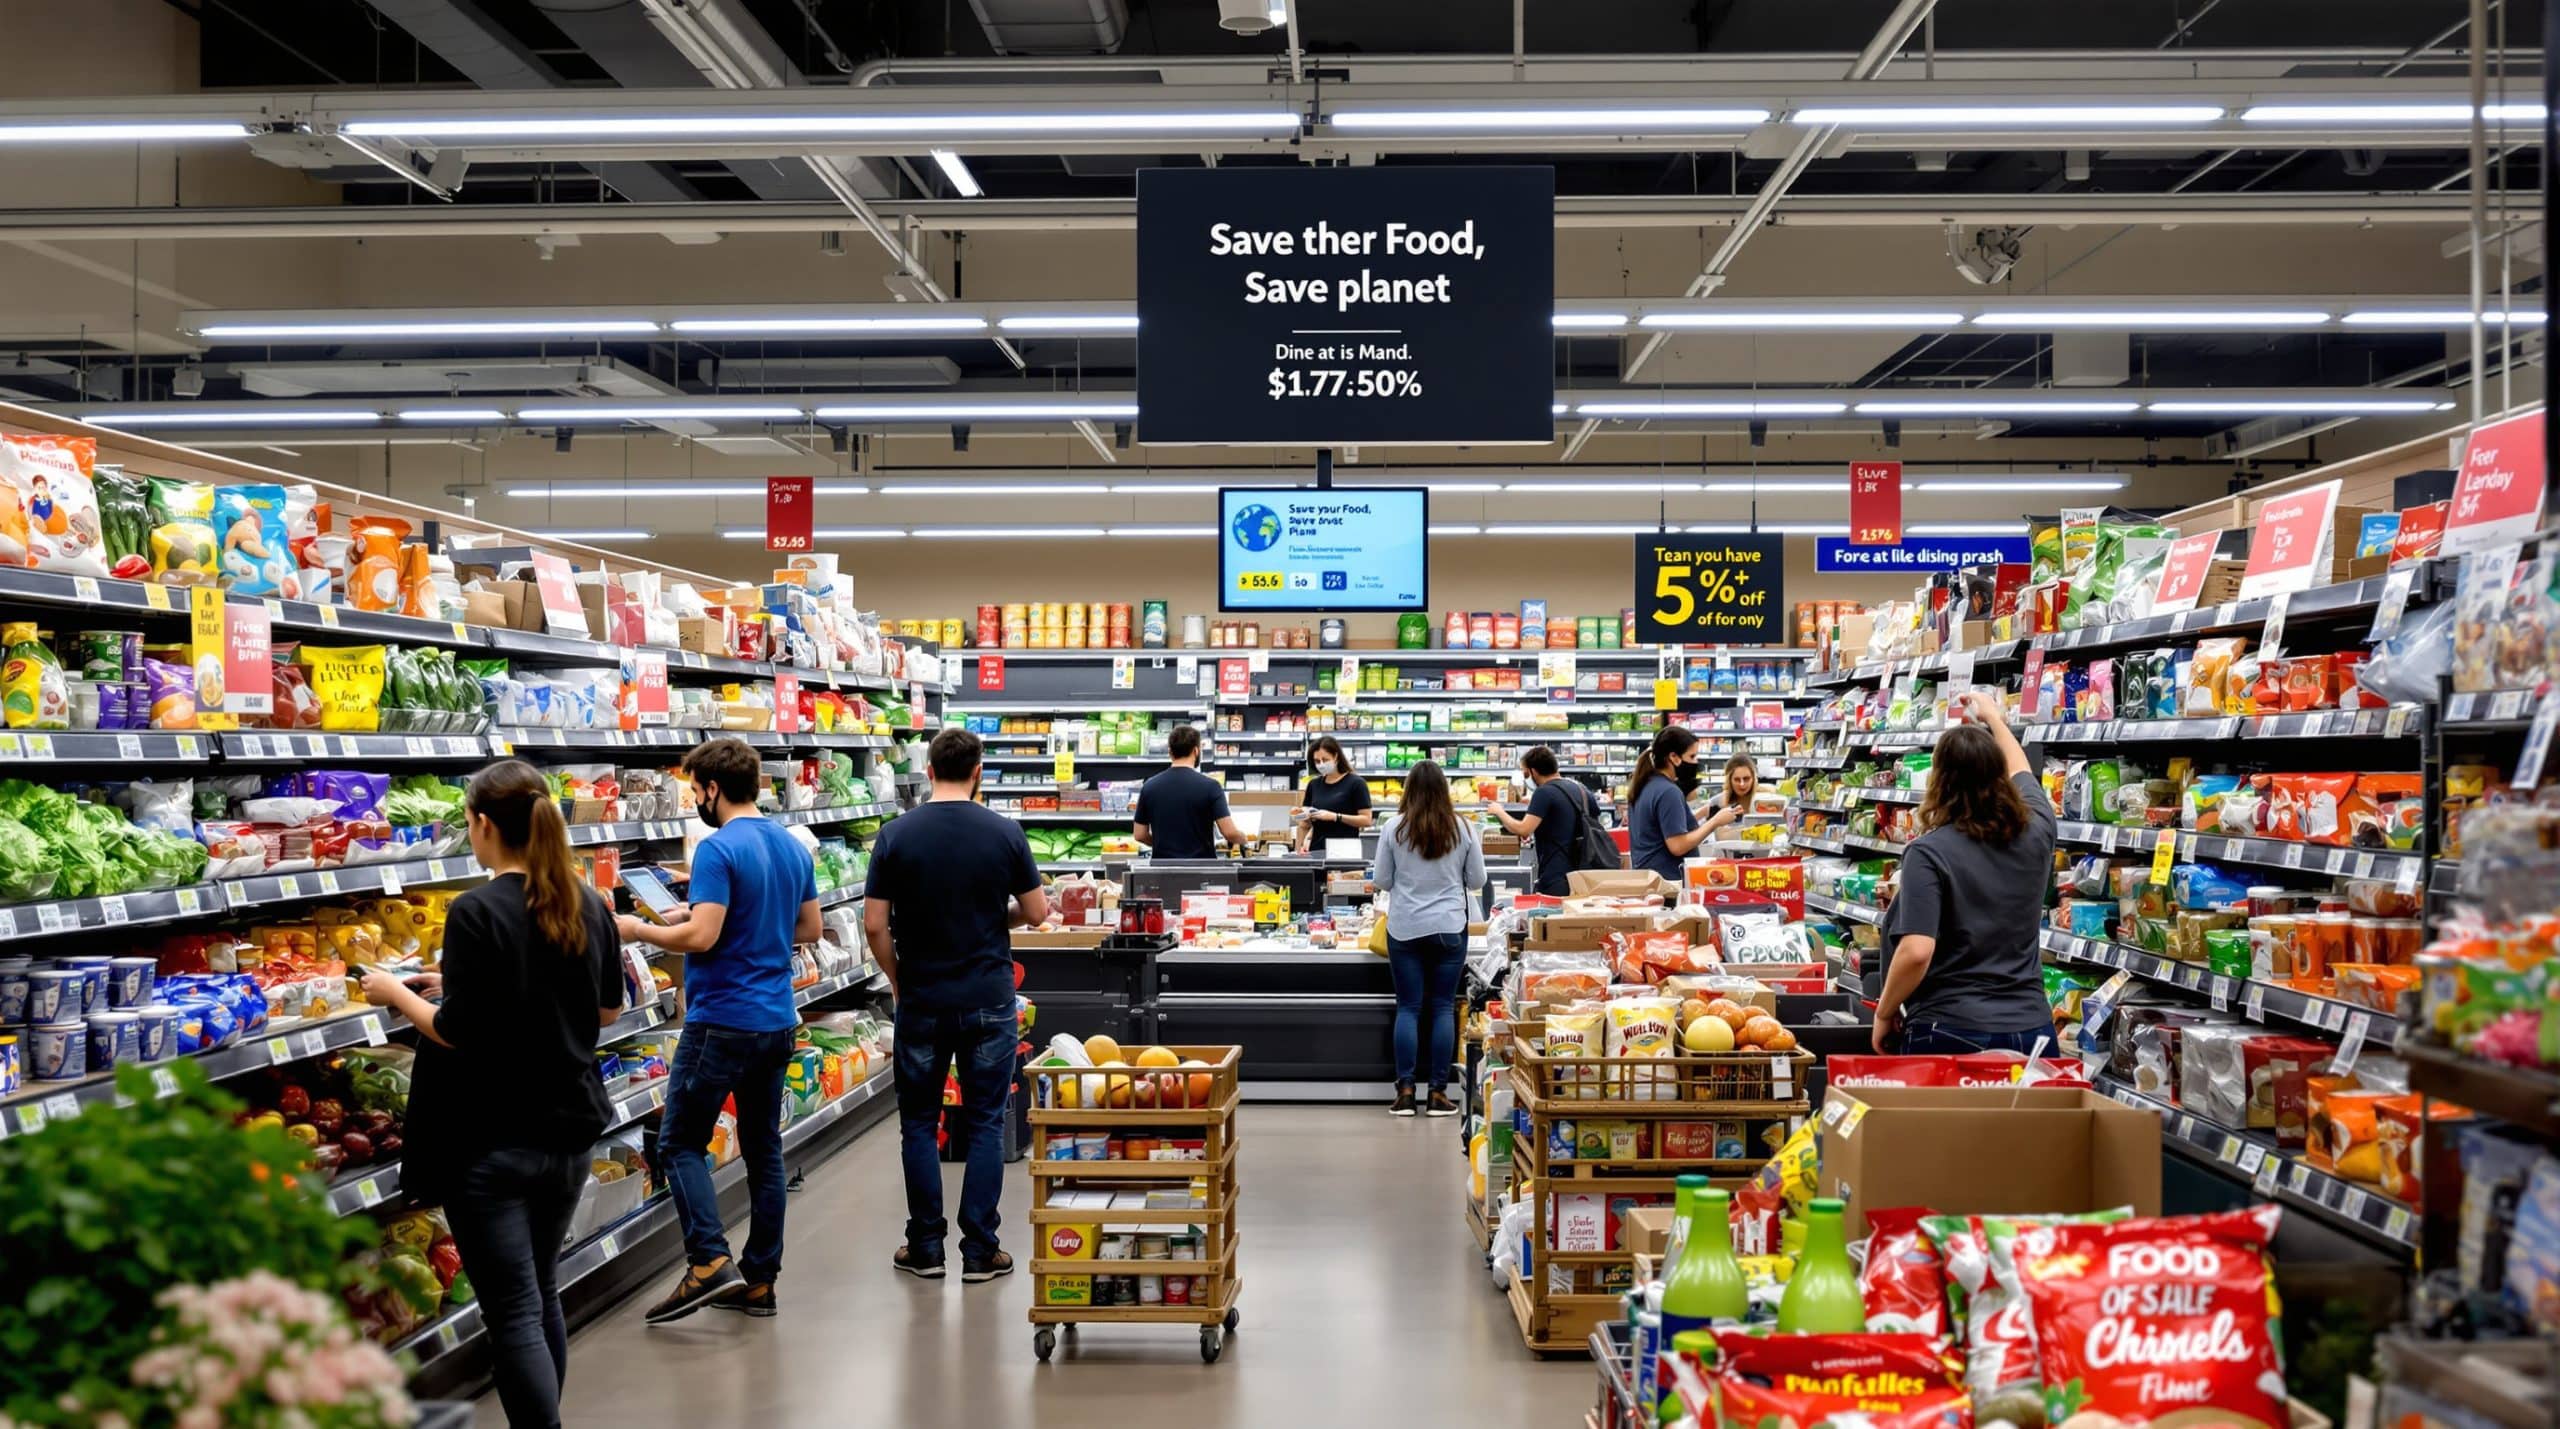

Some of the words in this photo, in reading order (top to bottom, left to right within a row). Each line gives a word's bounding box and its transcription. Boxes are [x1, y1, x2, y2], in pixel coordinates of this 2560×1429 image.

[1211, 223, 1294, 256] Save
[1303, 221, 1377, 256] ther
[1387, 220, 1485, 260] Food,
[1245, 272, 1328, 303] Save
[1339, 269, 1451, 312] planet
[1275, 344, 1314, 360] Dine
[1318, 346, 1335, 360] at
[1340, 344, 1354, 360] is
[1359, 344, 1413, 360] Mand.
[1653, 547, 1692, 562] Tean
[1695, 551, 1722, 566] you
[1725, 547, 1761, 562] have
[1835, 549, 1870, 563] Fore
[1872, 551, 1888, 563] at
[1917, 548, 1959, 566] dising
[1739, 590, 1766, 606] off
[2108, 1243, 2221, 1278] FOOD
[2101, 1285, 2140, 1316] OF
[2138, 1284, 2217, 1315] SALE
